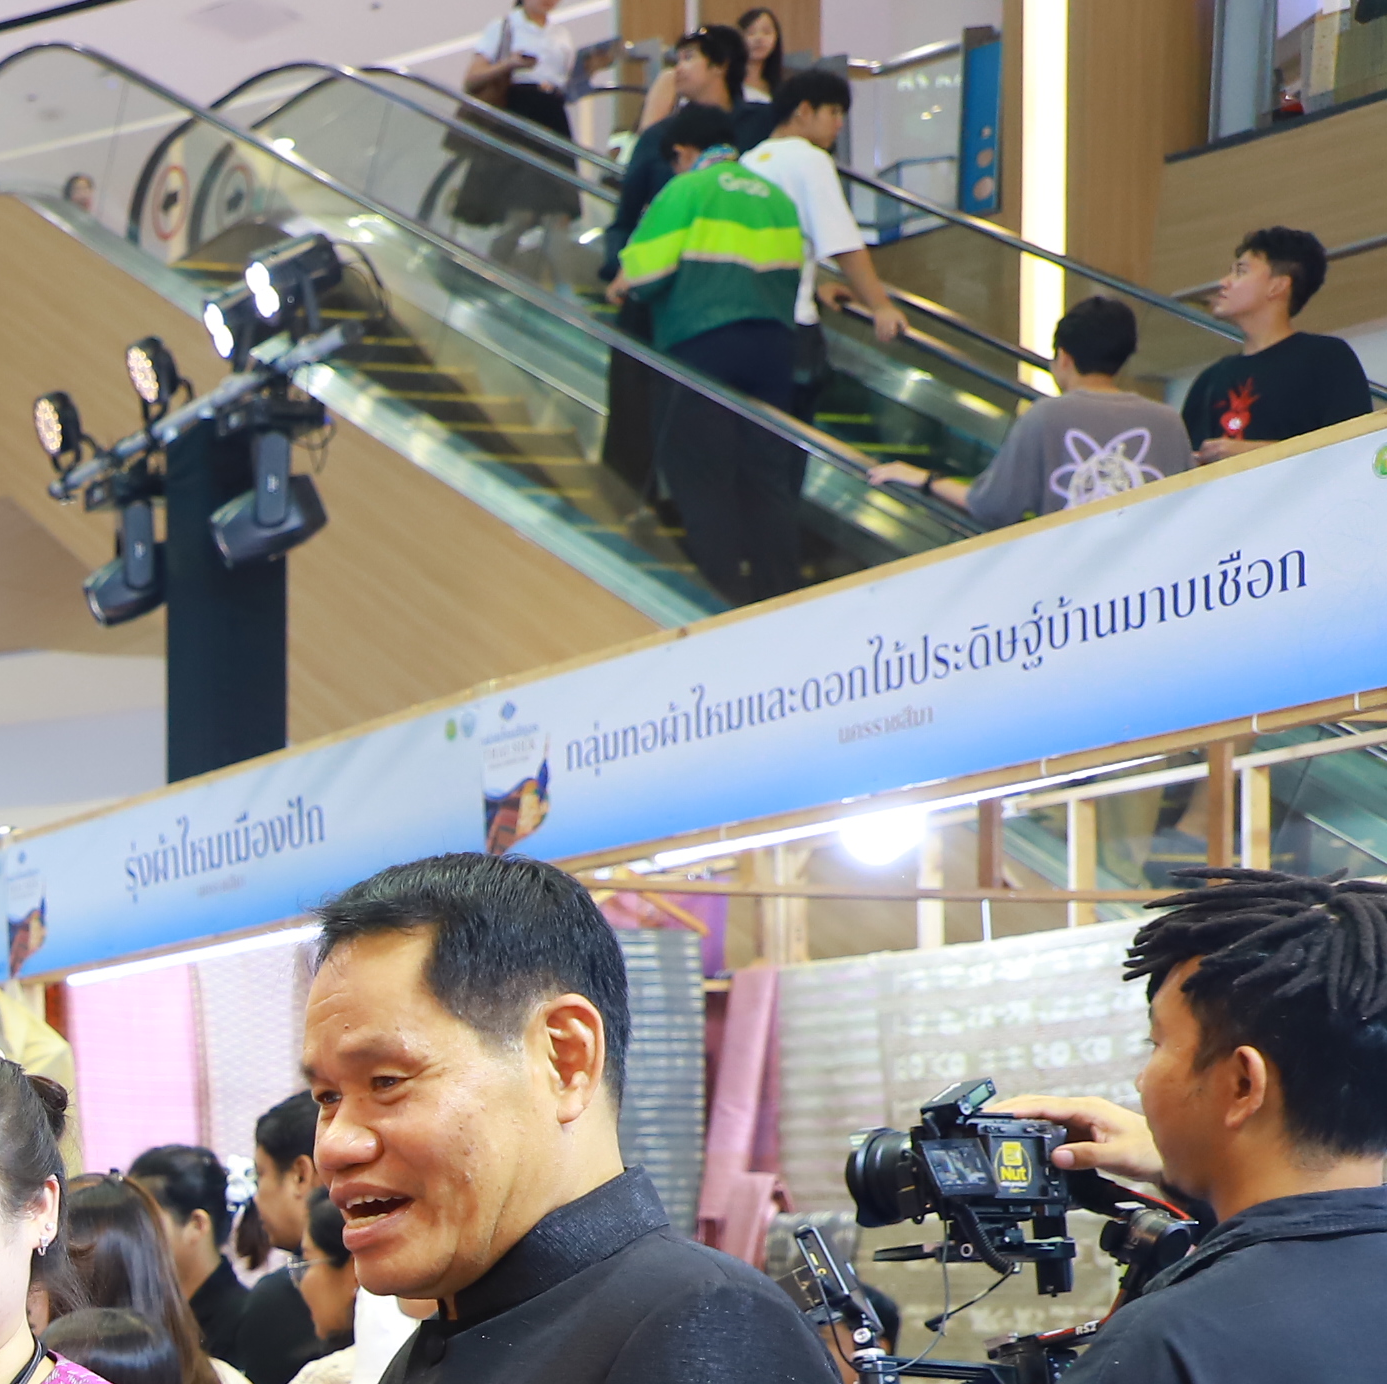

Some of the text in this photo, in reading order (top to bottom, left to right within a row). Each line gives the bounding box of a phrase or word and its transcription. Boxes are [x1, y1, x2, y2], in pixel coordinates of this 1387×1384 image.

[565, 549, 1308, 777] กลุ่มทอผ้าไหมและดอกไม้ประดิษฐ์บ้านมาบเชือก
[1000, 1166, 1028, 1181] Nut
